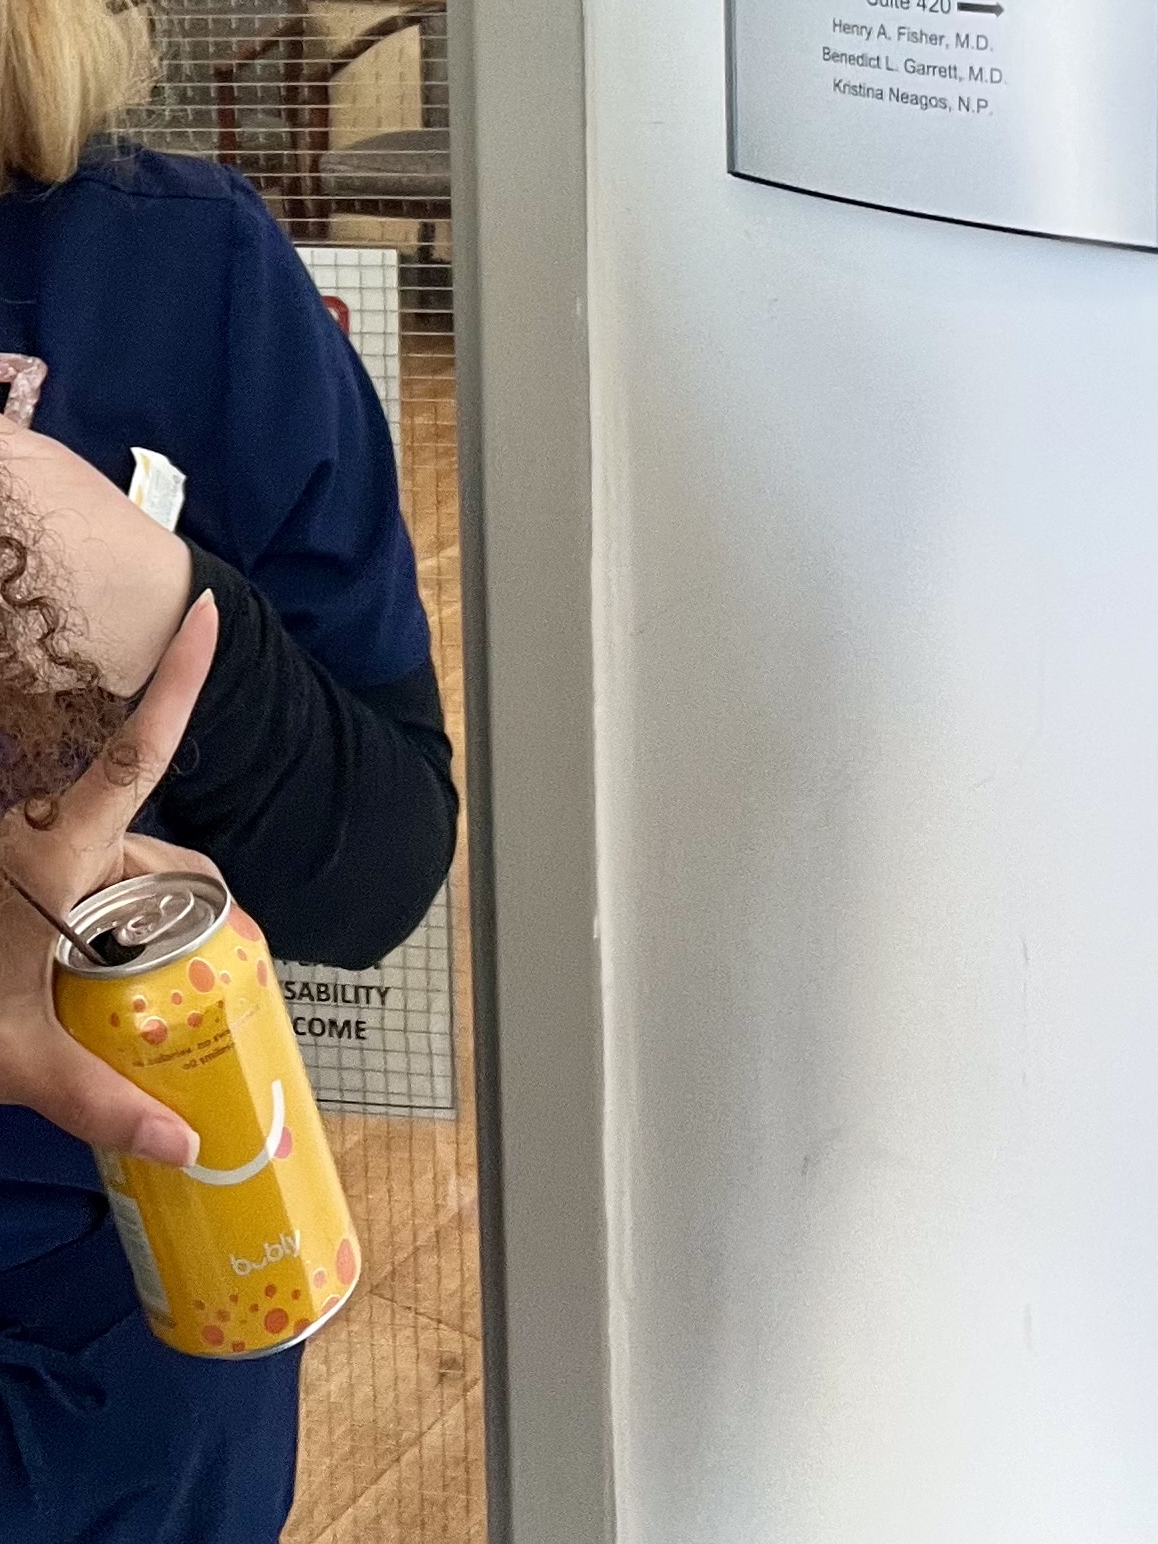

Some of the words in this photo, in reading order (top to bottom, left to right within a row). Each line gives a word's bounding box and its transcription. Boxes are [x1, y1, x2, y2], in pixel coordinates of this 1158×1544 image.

[832, 18, 873, 41] Henry
[877, 24, 891, 40] A.
[897, 26, 949, 49] Fisher,
[955, 32, 994, 52] M.D.
[822, 46, 881, 69] Benedict
[886, 56, 899, 71] L.
[904, 58, 963, 82] Garrett,
[968, 65, 1007, 85] M.D.
[832, 78, 883, 100] Kristina
[889, 87, 951, 112] Neagos,
[958, 95, 993, 116] N.P.
[284, 981, 392, 1005] SABILITY
[293, 1017, 367, 1040] COME
[229, 1229, 301, 1275] bubly
